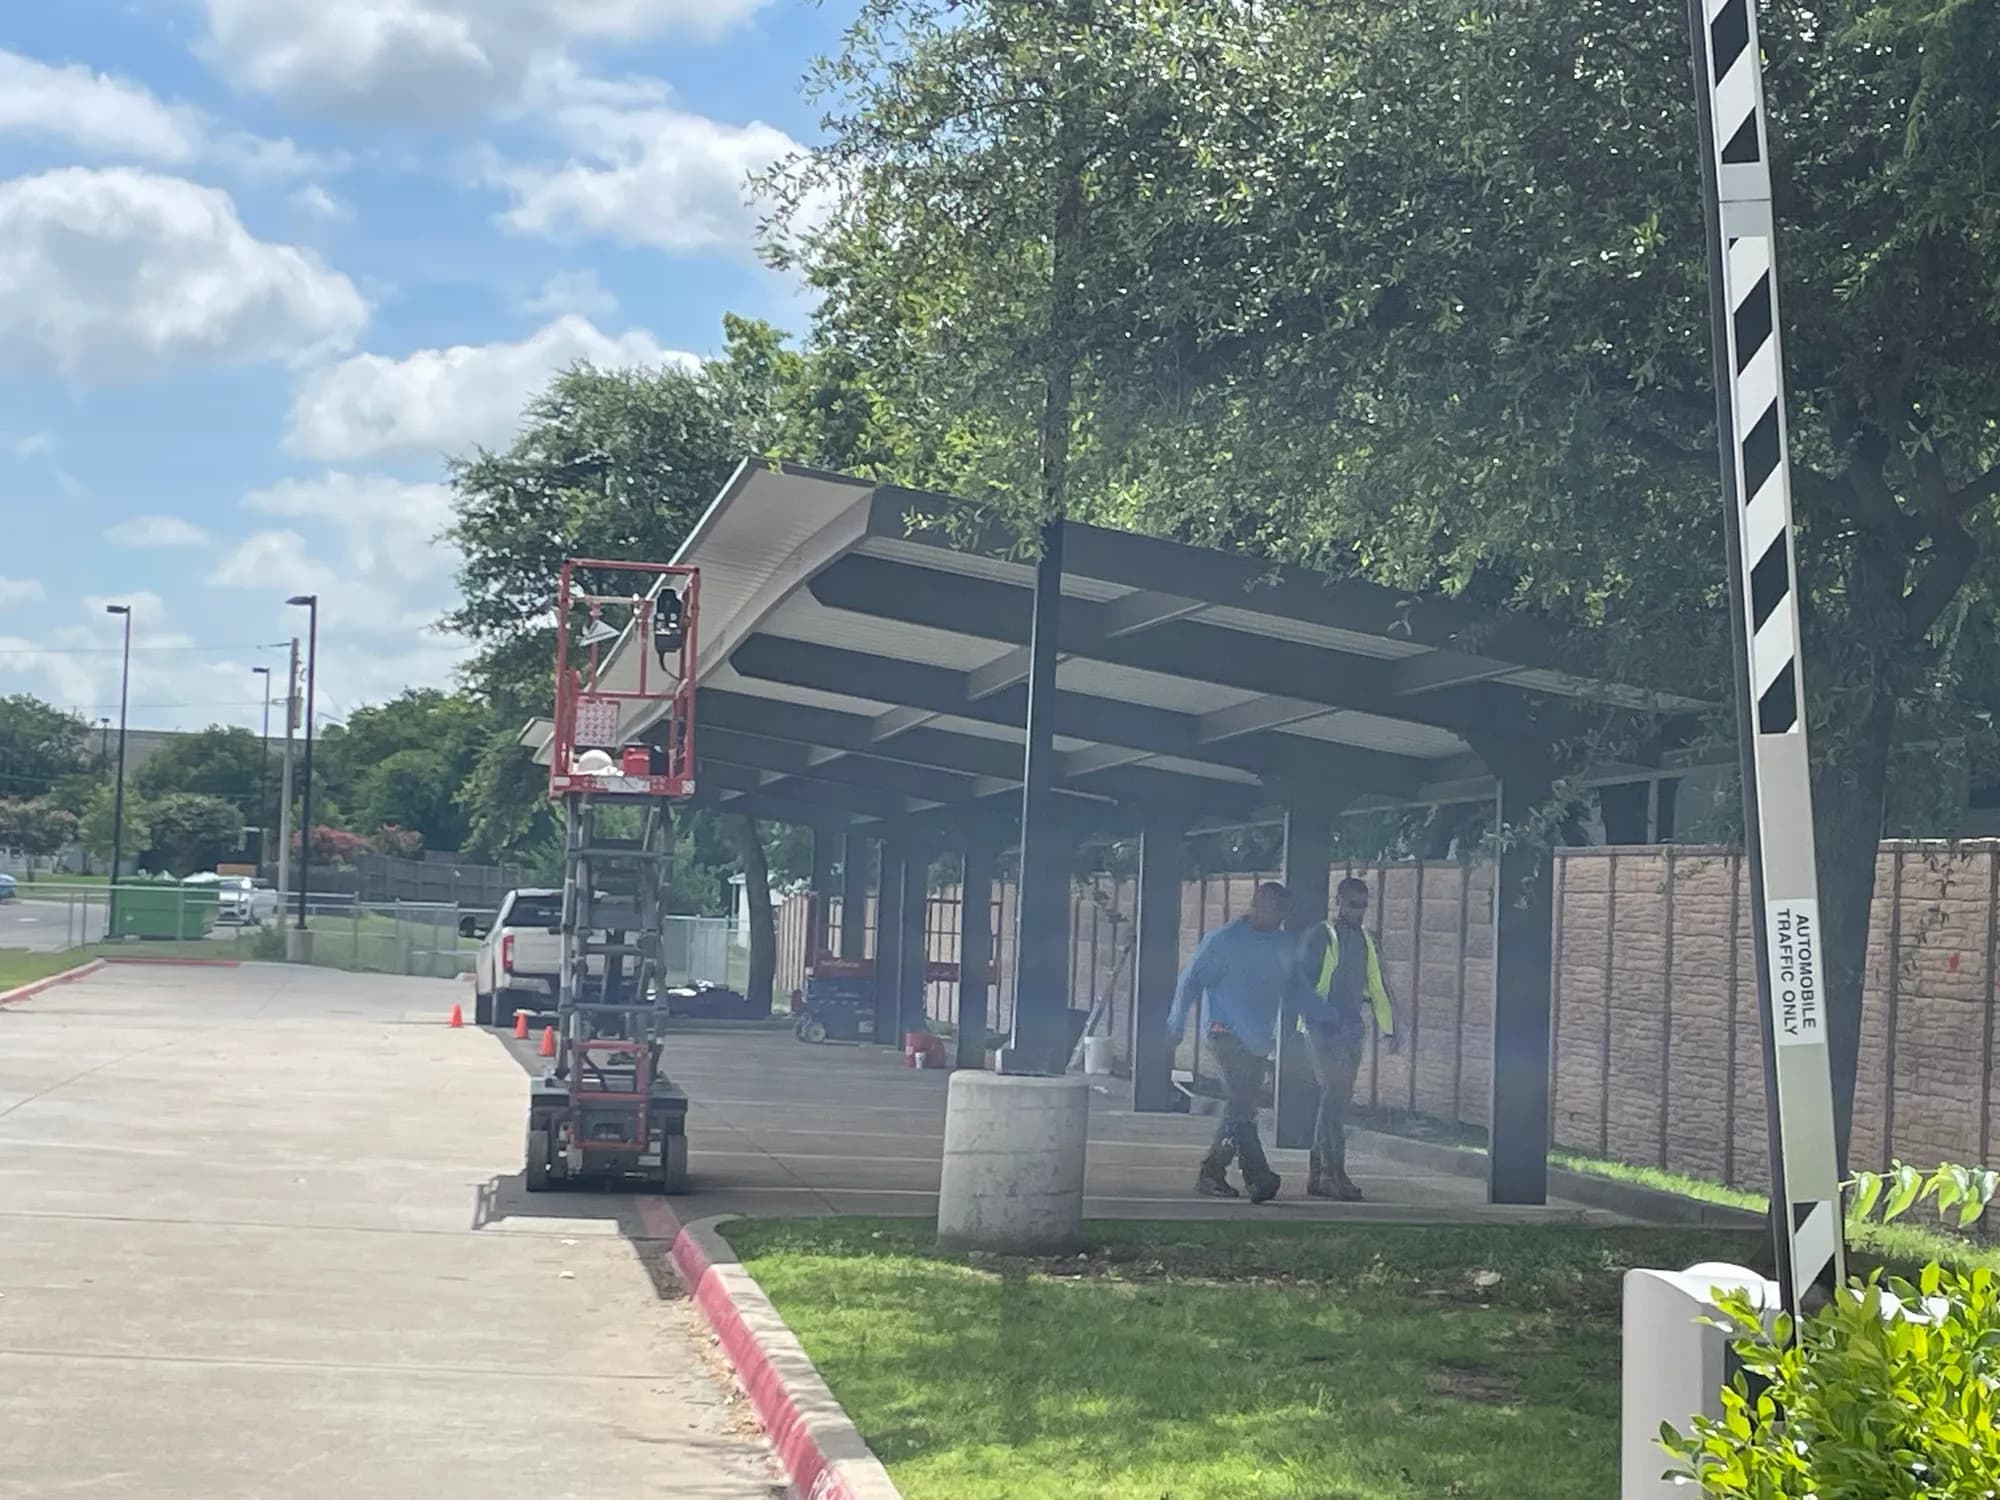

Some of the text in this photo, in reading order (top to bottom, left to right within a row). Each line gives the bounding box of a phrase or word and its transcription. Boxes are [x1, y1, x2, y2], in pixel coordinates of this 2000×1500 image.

[1777, 908, 1798, 1036] TRAFFIC ONLY
[1796, 914, 1816, 1029] AUTOMOBILE
